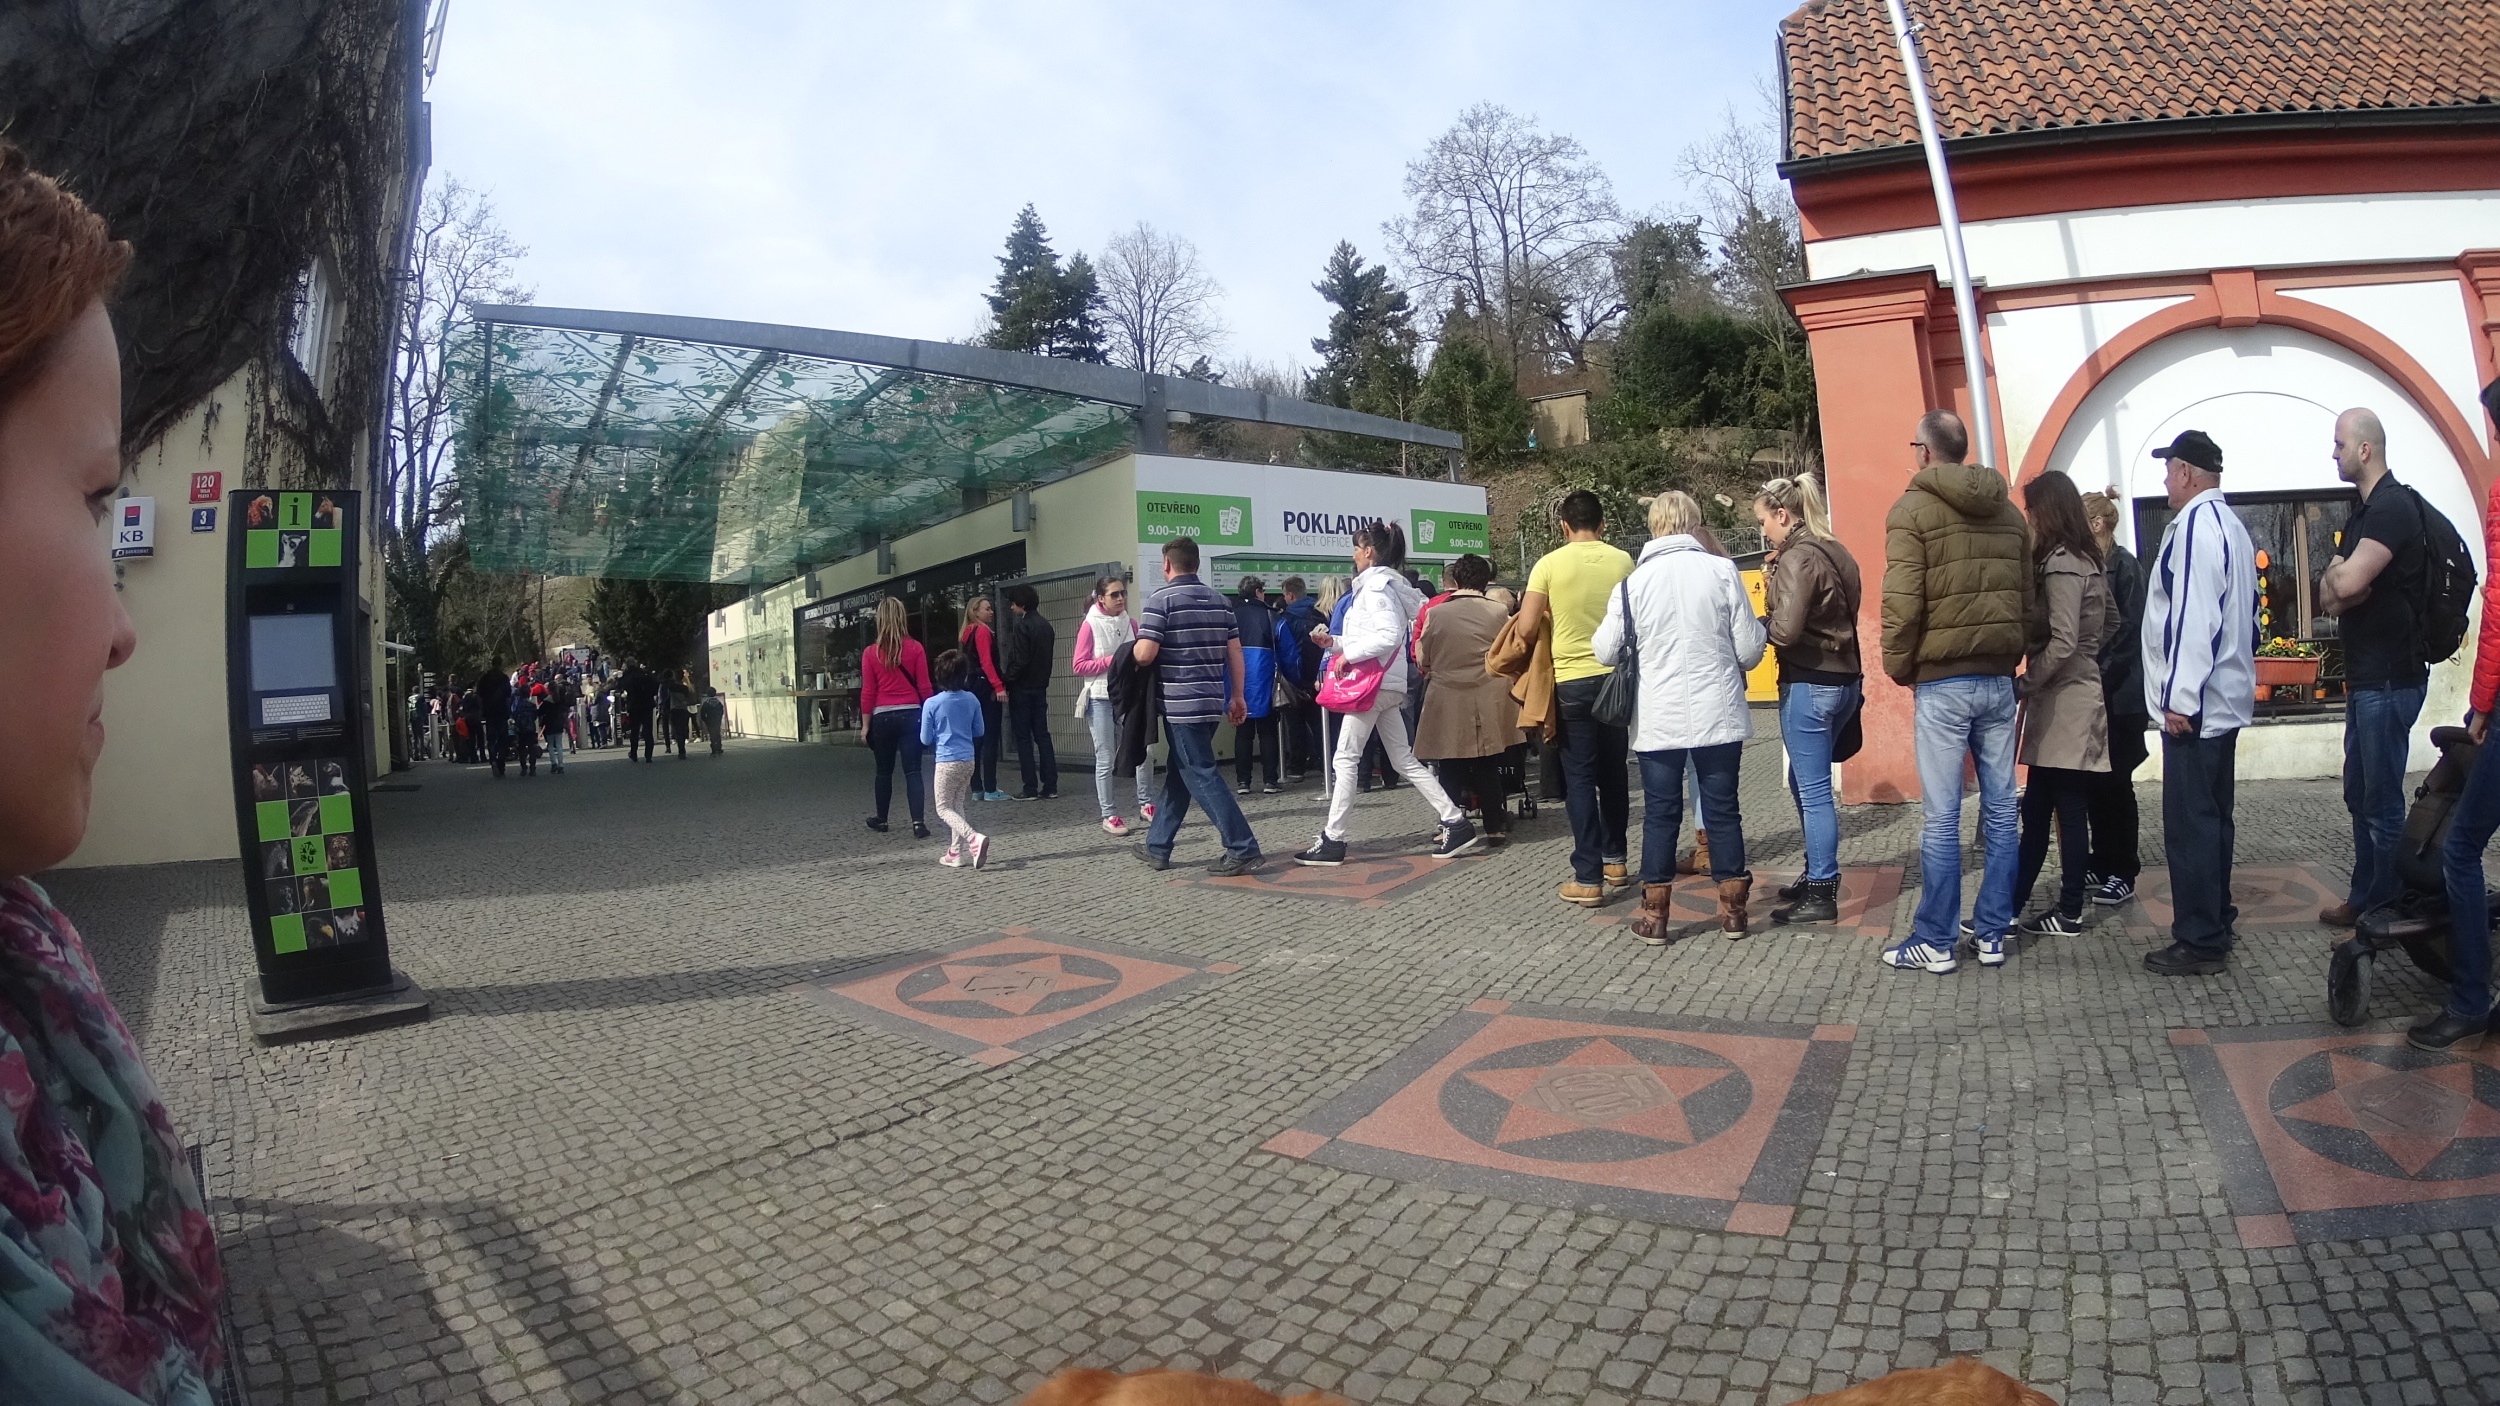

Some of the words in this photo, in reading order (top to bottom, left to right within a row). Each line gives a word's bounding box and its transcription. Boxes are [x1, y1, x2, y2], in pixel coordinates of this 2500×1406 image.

[196, 475, 214, 489] 120
[289, 497, 301, 526] i
[1146, 501, 1200, 515] OTEVŘENO
[200, 510, 207, 525] 3
[1448, 520, 1483, 531] OTEVŘENO
[120, 530, 144, 543] KB
[1285, 534, 1317, 546] TICKET
[1320, 536, 1351, 548] OFFICE
[1213, 563, 1241, 571] VSTUPNÉ
[1754, 582, 1761, 590] 4
